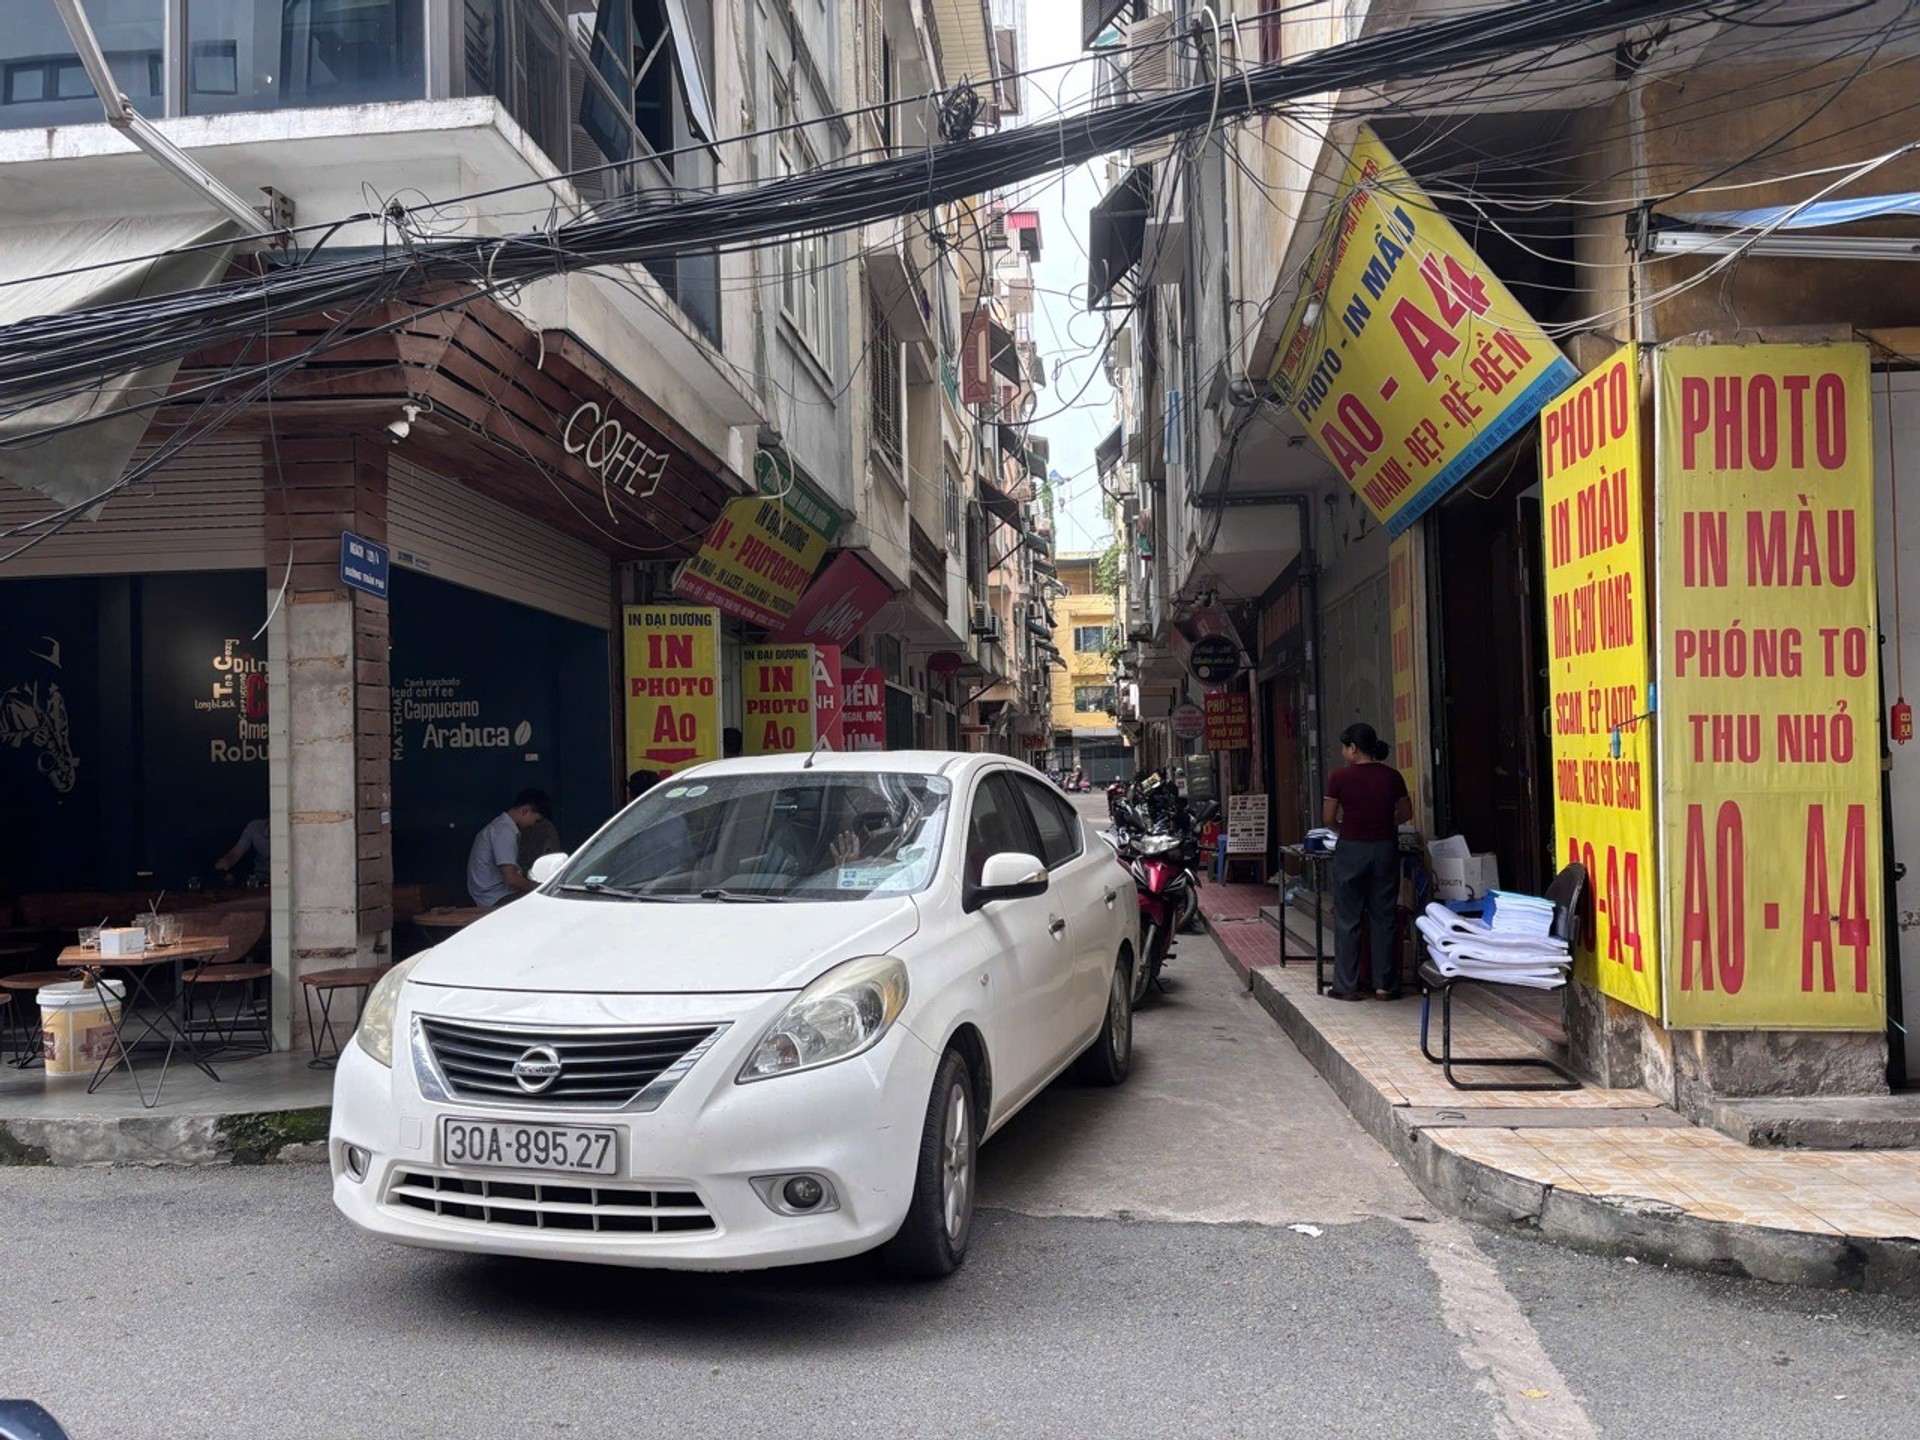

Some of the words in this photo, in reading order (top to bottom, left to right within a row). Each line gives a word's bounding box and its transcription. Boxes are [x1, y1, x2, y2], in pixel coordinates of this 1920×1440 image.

[1390, 251, 1492, 384] A4
[1297, 346, 1342, 424] PHOTO
[1342, 293, 1372, 338] IN
[1362, 455, 1413, 512] NHANH
[1404, 417, 1446, 468] ĐẸP
[1440, 373, 1484, 429] RẺ
[1546, 361, 1629, 480] PHOTO
[1682, 373, 1848, 471] PHOTO
[1551, 497, 1571, 570] IN
[1577, 464, 1629, 560] MÀU
[1683, 511, 1728, 588] IN
[1746, 493, 1856, 588] MÀU
[628, 613, 642, 627] IN
[645, 612, 667, 629] ĐẠI
[669, 611, 712, 627] DƯƠNG
[1553, 592, 1572, 674] MẠ
[1599, 564, 1634, 650] VÀNG
[1675, 619, 1802, 678] PHÓNG
[1819, 627, 1867, 679] TO
[647, 634, 694, 669] IN
[758, 666, 794, 693] IN
[404, 700, 480, 722] Cappuccino
[631, 677, 714, 698] PHOTO
[746, 699, 809, 715] PHOTO
[1556, 691, 1586, 738] SCAN,
[1588, 681, 1602, 735] ÉP
[422, 722, 510, 749] Arabica
[1689, 714, 1761, 763] THU
[1777, 700, 1855, 764] NHỎ
[1615, 752, 1641, 811] SÁCH
[1801, 804, 1871, 994] A4
[450, 1125, 612, 1170] 30A-895.27
